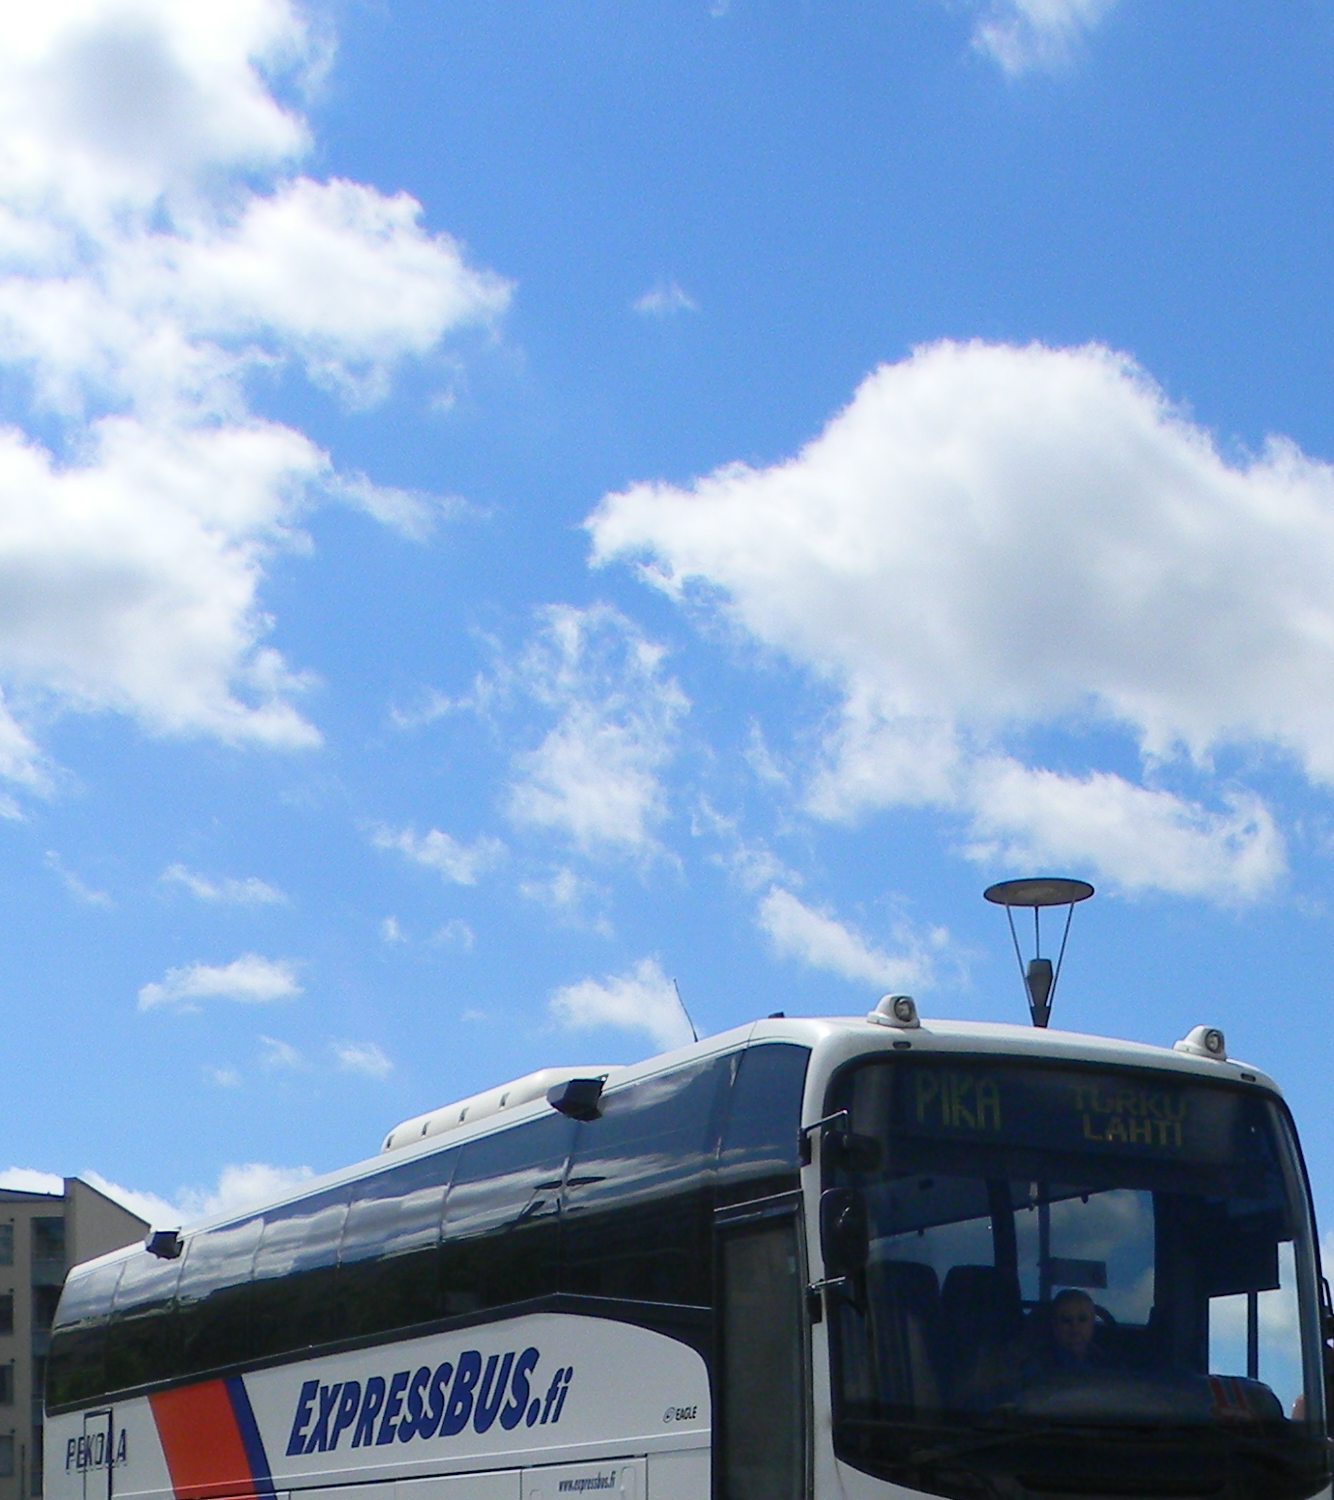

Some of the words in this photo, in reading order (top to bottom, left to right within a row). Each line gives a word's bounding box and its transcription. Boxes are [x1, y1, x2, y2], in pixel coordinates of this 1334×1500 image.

[915, 1070, 1001, 1131] PIKA
[1070, 1083, 1187, 1119] TURKU
[1082, 1112, 1184, 1147] LAHTI
[676, 1405, 698, 1421] EAGLE
